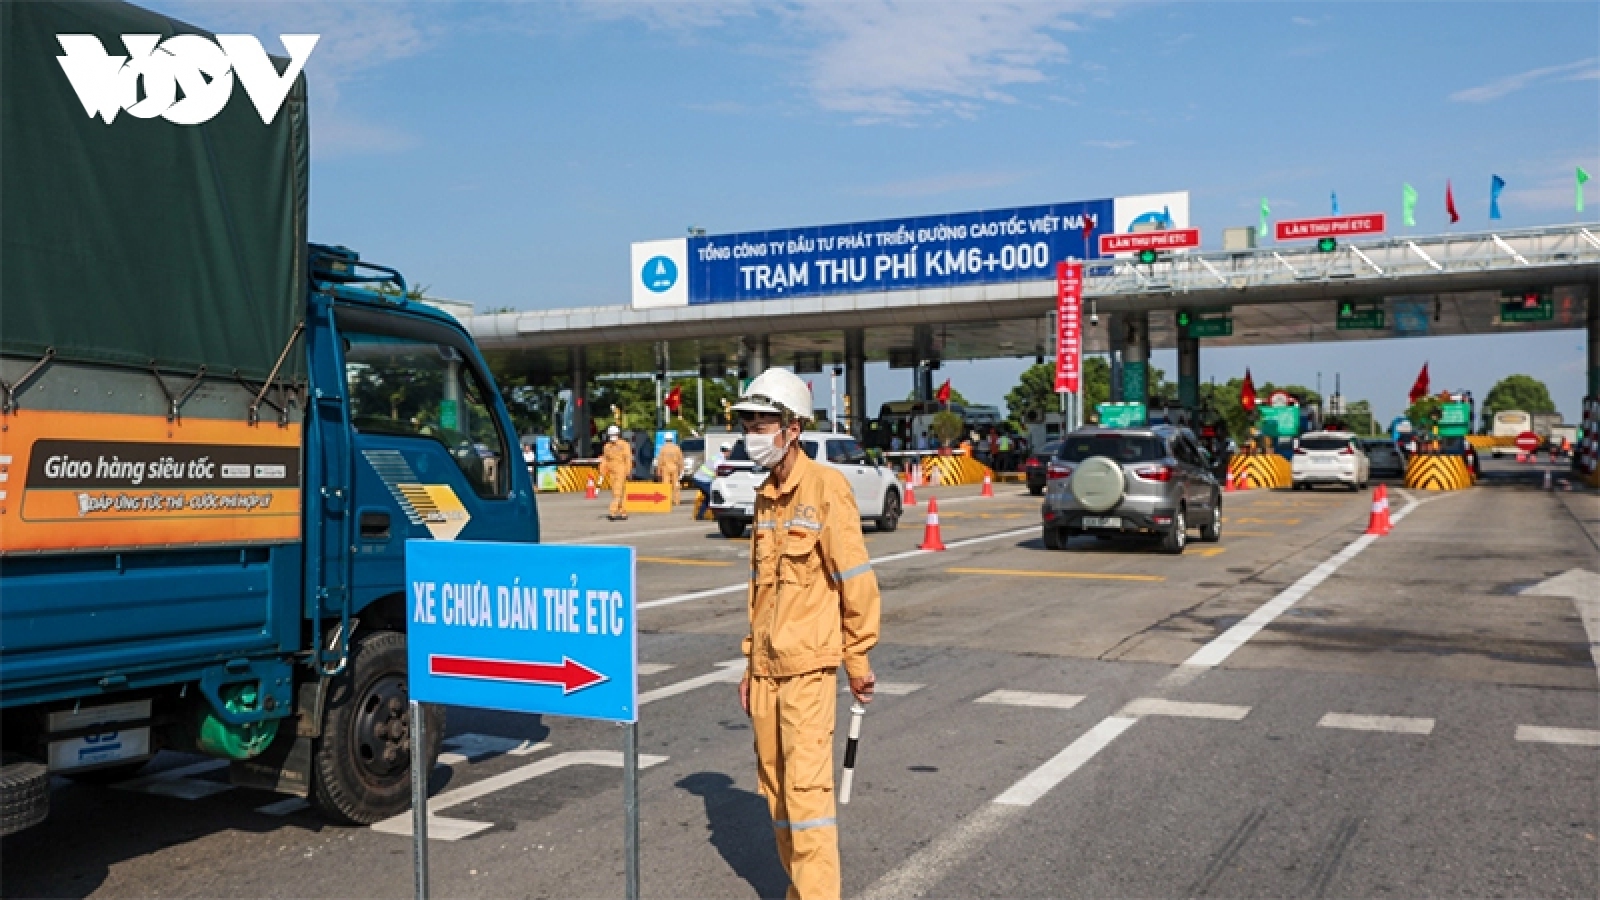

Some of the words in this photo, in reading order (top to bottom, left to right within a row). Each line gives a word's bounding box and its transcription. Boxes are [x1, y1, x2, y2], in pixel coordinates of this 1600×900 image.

[734, 241, 767, 259] CÔNG
[770, 242, 785, 255] TY
[817, 236, 835, 252] TƯ
[837, 231, 872, 250] PHÁT
[1028, 215, 1061, 235] VIỆT
[1351, 219, 1371, 231] ETC
[740, 261, 809, 293] TRẠM
[814, 256, 867, 285] THU
[874, 244, 918, 281] PHÍ
[925, 242, 1049, 277] KM6+000
[44, 455, 92, 479] Giao
[96, 455, 146, 485] hàng
[148, 456, 185, 479] siêu
[188, 456, 216, 479] tốc
[413, 581, 437, 625] XE
[441, 579, 493, 628] CHƯA
[497, 575, 539, 631] DÁN
[542, 573, 581, 633] THẺ
[585, 589, 624, 636] ETC
